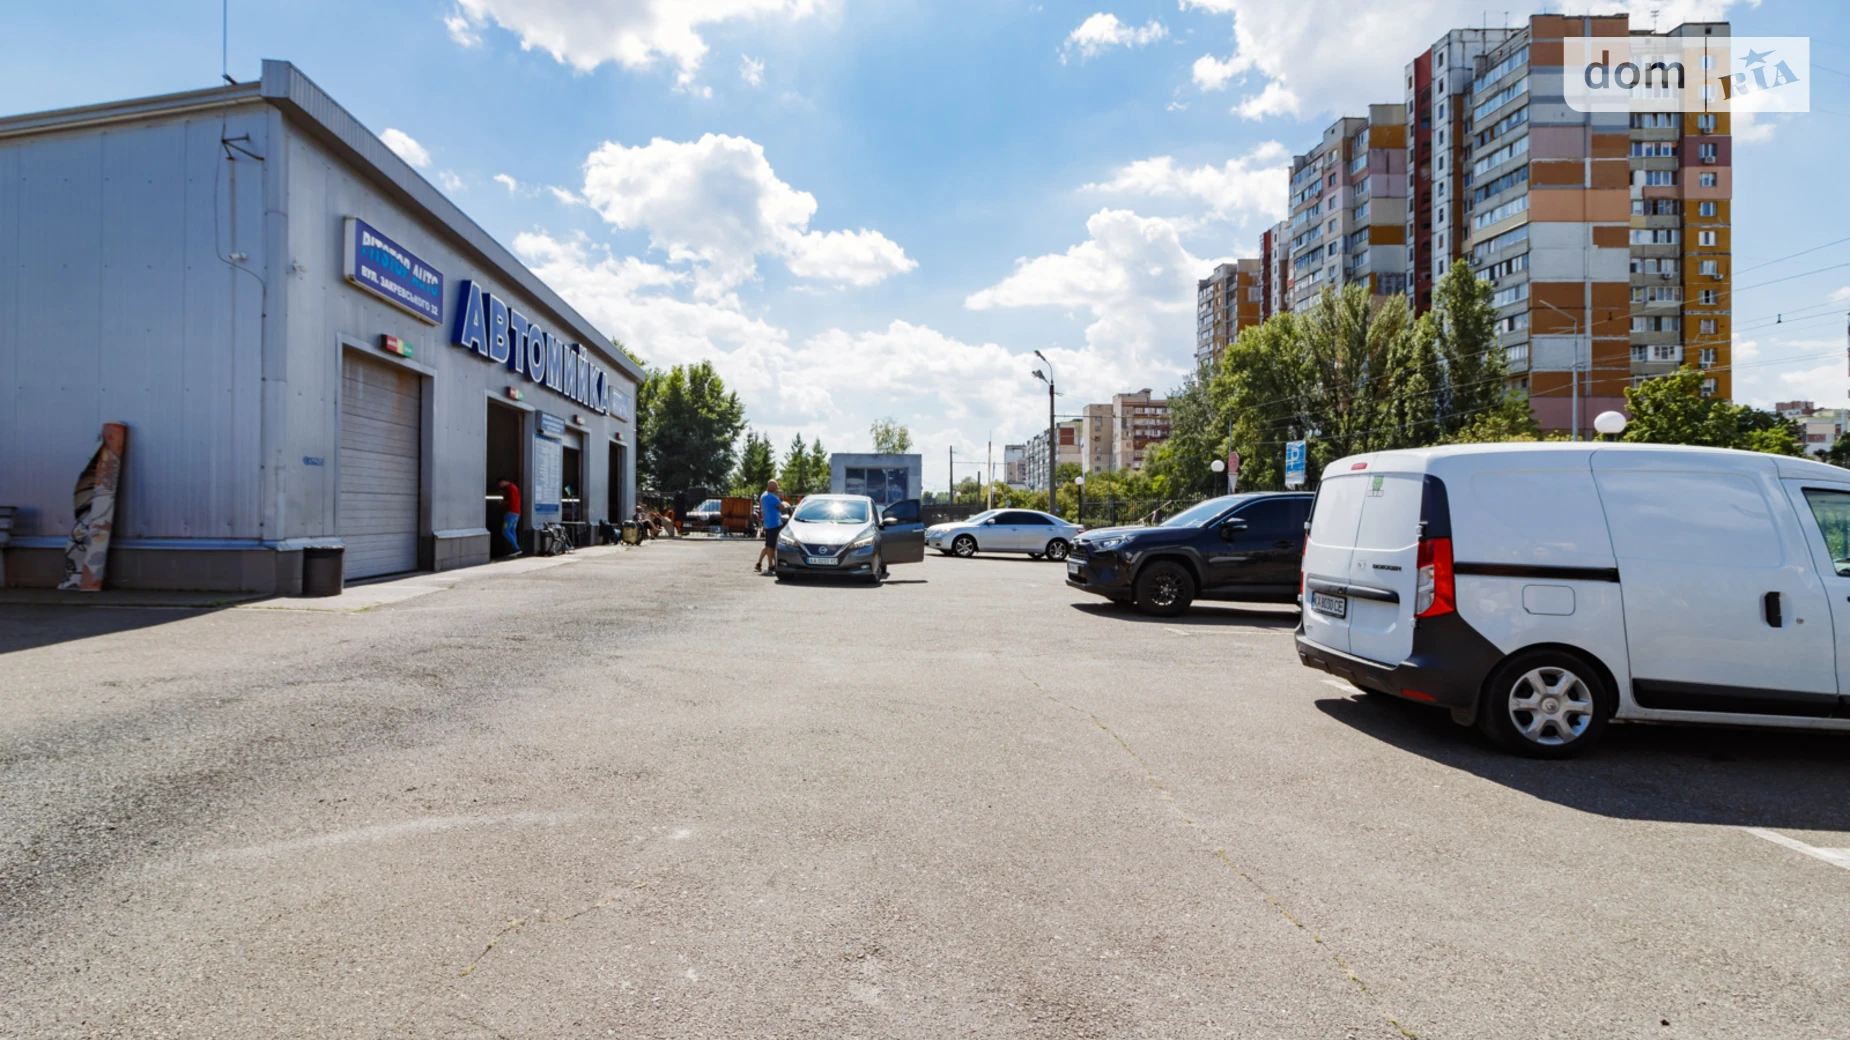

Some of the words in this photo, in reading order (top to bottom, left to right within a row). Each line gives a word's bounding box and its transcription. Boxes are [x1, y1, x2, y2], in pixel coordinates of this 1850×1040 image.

[379, 275, 430, 311] ЗАКРЕВСЬКОГО
[430, 303, 438, 316] 32
[411, 264, 439, 297] AUTO
[458, 280, 610, 416] АВТОМИЙКА
